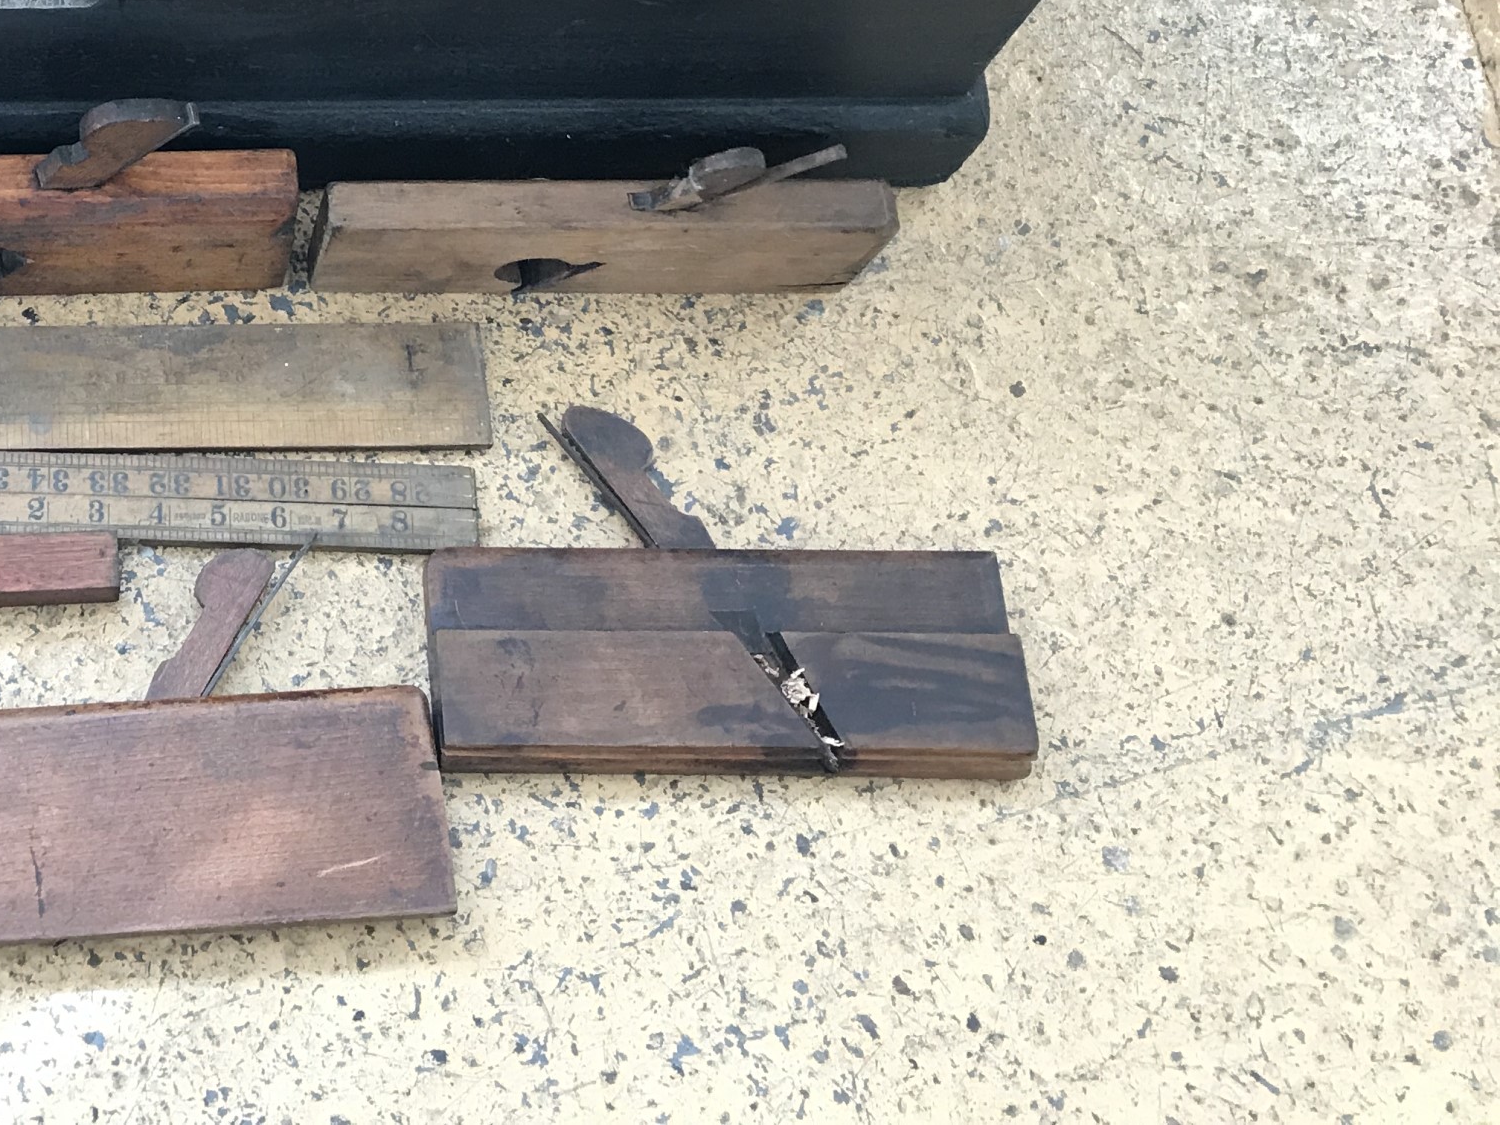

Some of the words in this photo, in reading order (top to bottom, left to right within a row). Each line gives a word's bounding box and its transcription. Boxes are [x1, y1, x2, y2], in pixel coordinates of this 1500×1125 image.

[27, 468, 69, 492] 34
[88, 470, 129, 493] 33
[149, 472, 190, 495] 32
[215, 474, 251, 498] 31
[268, 476, 309, 499] 30
[330, 478, 371, 501] 29
[27, 496, 46, 520] 2
[88, 499, 105, 522] 3
[149, 501, 167, 525] 4
[210, 503, 227, 527] 5
[271, 505, 287, 528] 6
[331, 507, 348, 530] 7
[391, 509, 409, 532] 8
